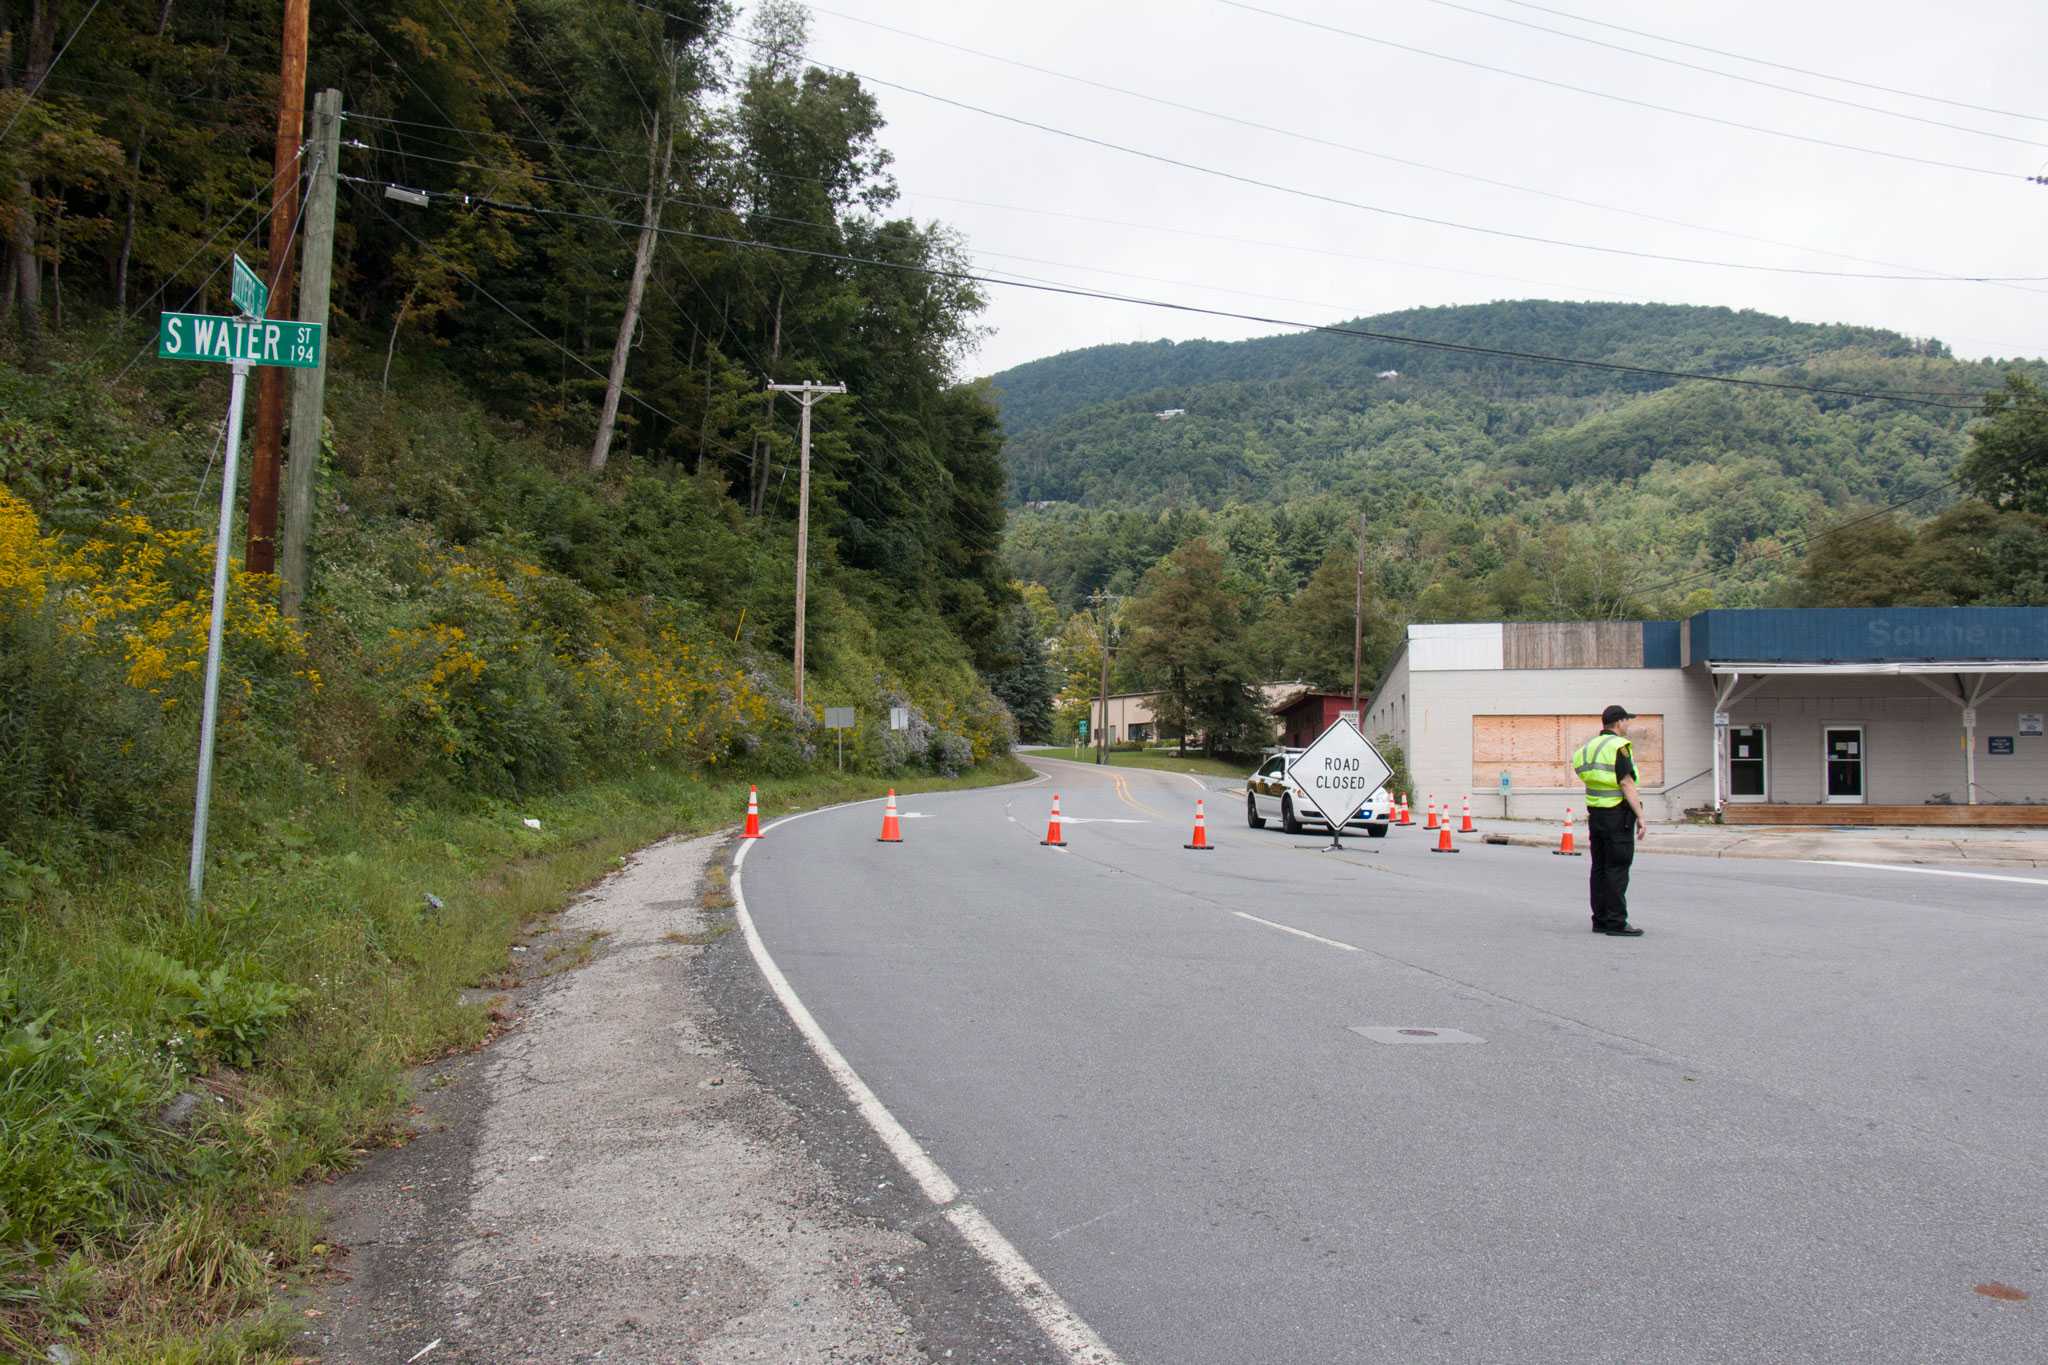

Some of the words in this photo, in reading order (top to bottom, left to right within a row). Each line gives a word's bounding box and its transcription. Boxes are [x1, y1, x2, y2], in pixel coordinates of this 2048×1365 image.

[166, 317, 182, 354] S
[193, 319, 281, 361] WATER
[297, 327, 312, 344] ST
[290, 345, 314, 363] 194
[1324, 757, 1360, 772] ROAD
[1315, 775, 1365, 790] CLOSED
